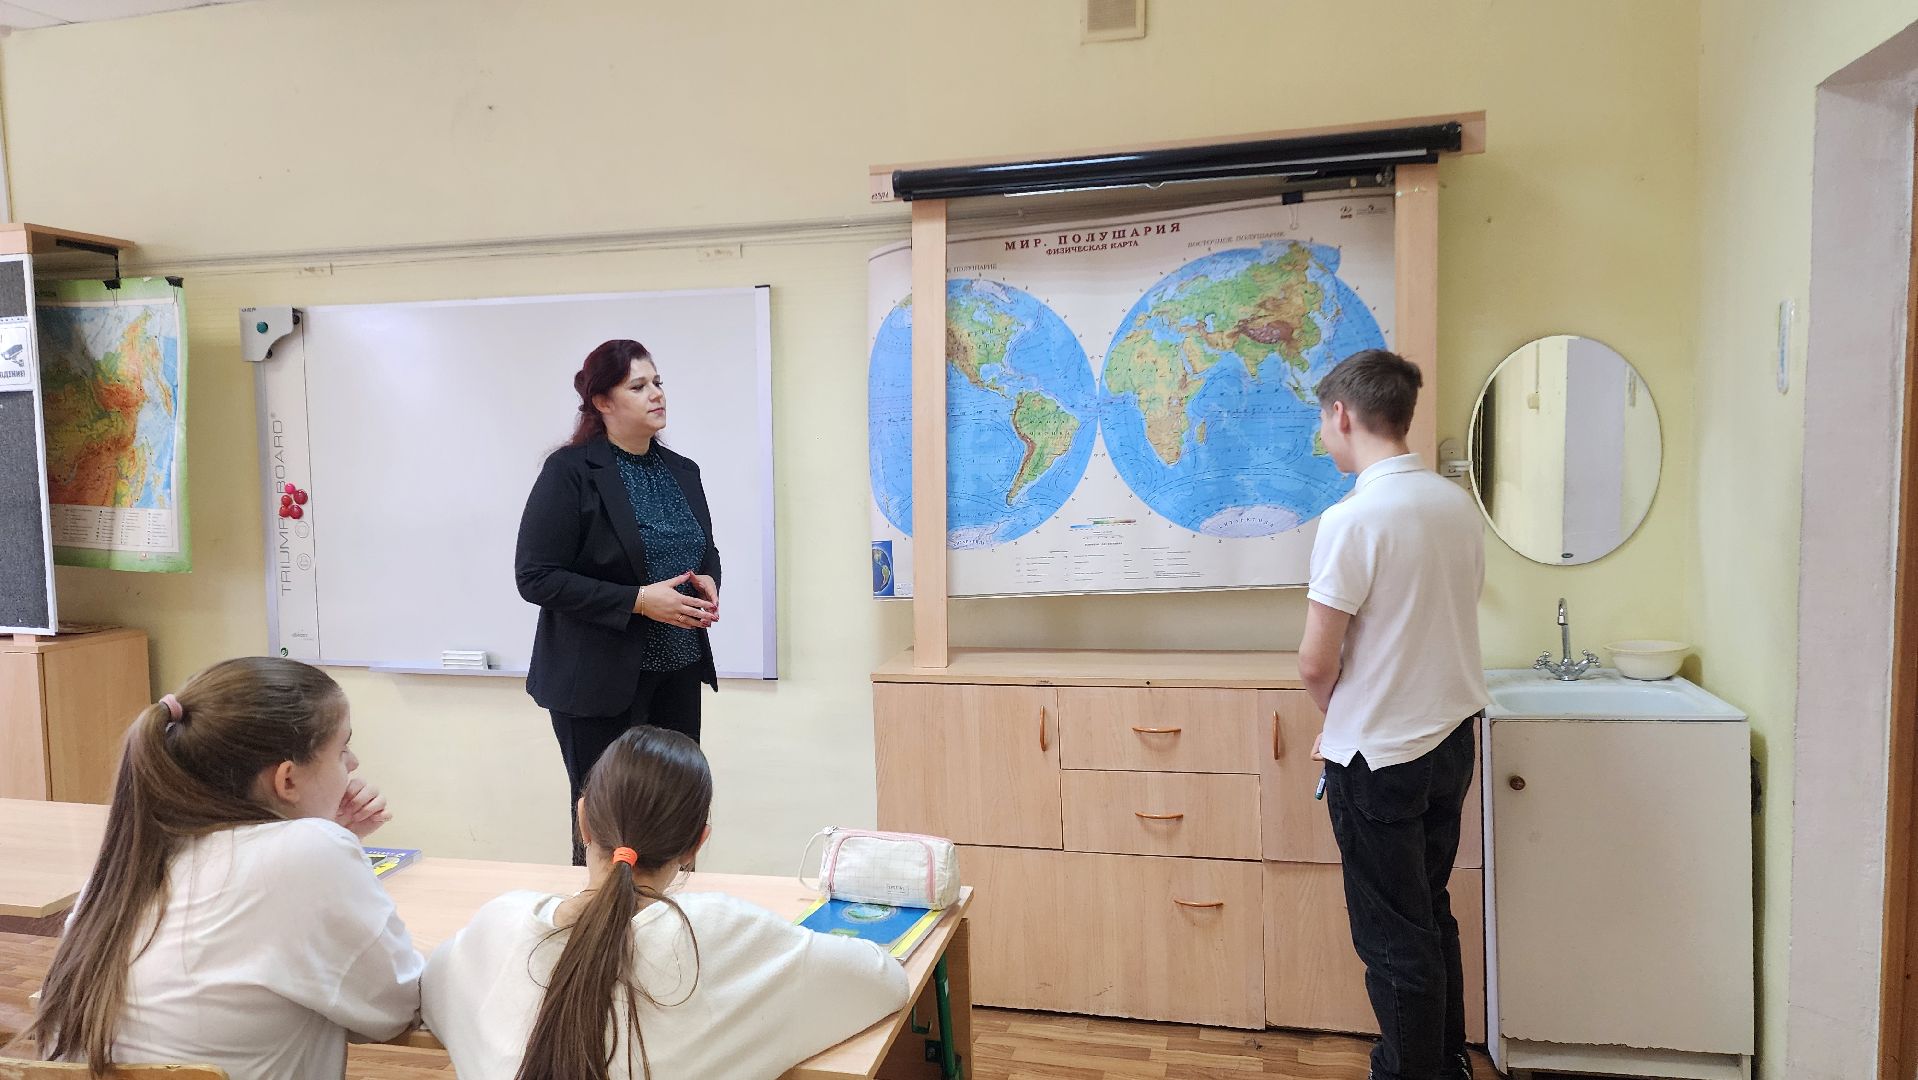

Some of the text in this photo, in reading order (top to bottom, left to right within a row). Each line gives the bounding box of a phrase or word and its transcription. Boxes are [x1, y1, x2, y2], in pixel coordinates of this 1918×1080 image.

[1005, 222, 1181, 251] МИР. ПОЛУШАРИЯ
[1046, 239, 1139, 256] ФИЗИЧЕСКАЯ КАРТА
[953, 263, 998, 273] ПОЛУШАРИЕ
[278, 510, 292, 597] TRIUMP
